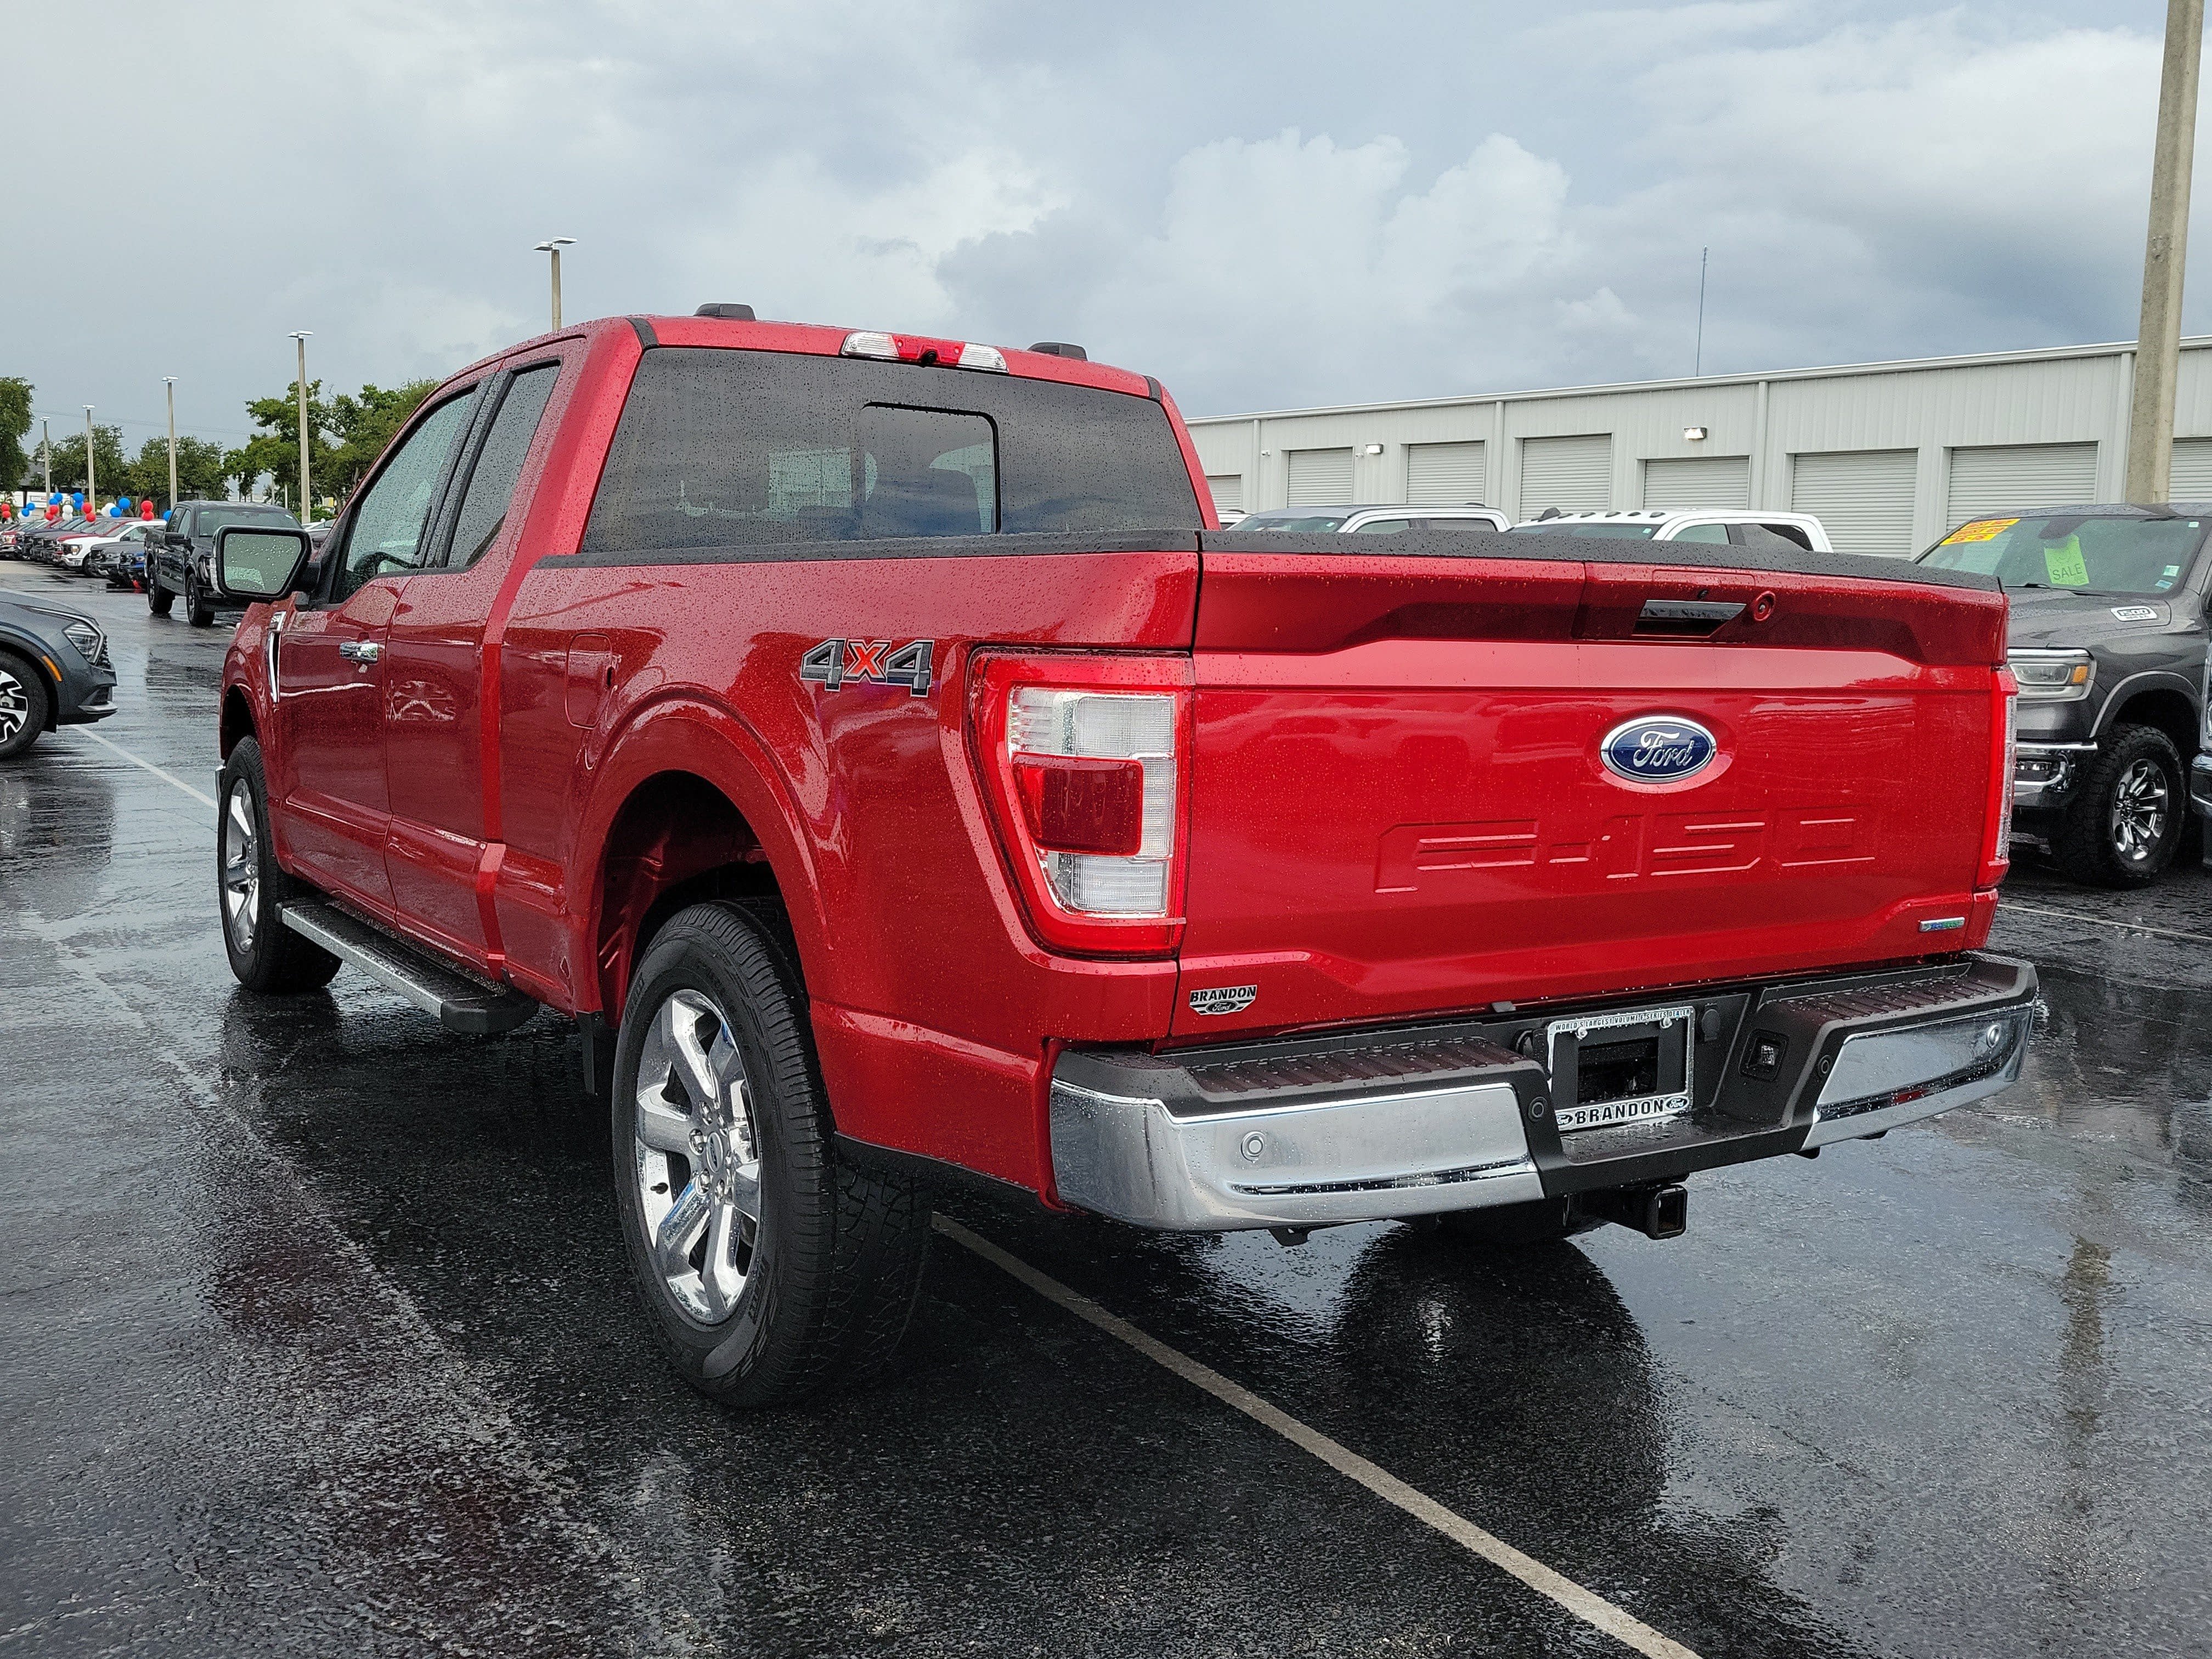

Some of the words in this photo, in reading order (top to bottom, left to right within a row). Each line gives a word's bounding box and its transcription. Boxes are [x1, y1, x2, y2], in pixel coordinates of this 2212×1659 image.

[2052, 563, 2083, 580] SALE
[1633, 731, 1694, 767] Ford
[1189, 986, 1256, 1002] BRANDON
[1212, 1002, 1232, 1012] Ford
[1585, 1018, 1612, 1027] LARGEST
[1615, 1014, 1639, 1024] VOLUME
[1669, 1008, 1690, 1018] DEALER
[1575, 1098, 1664, 1125] BRANDON
[1668, 1098, 1686, 1109] Ford
